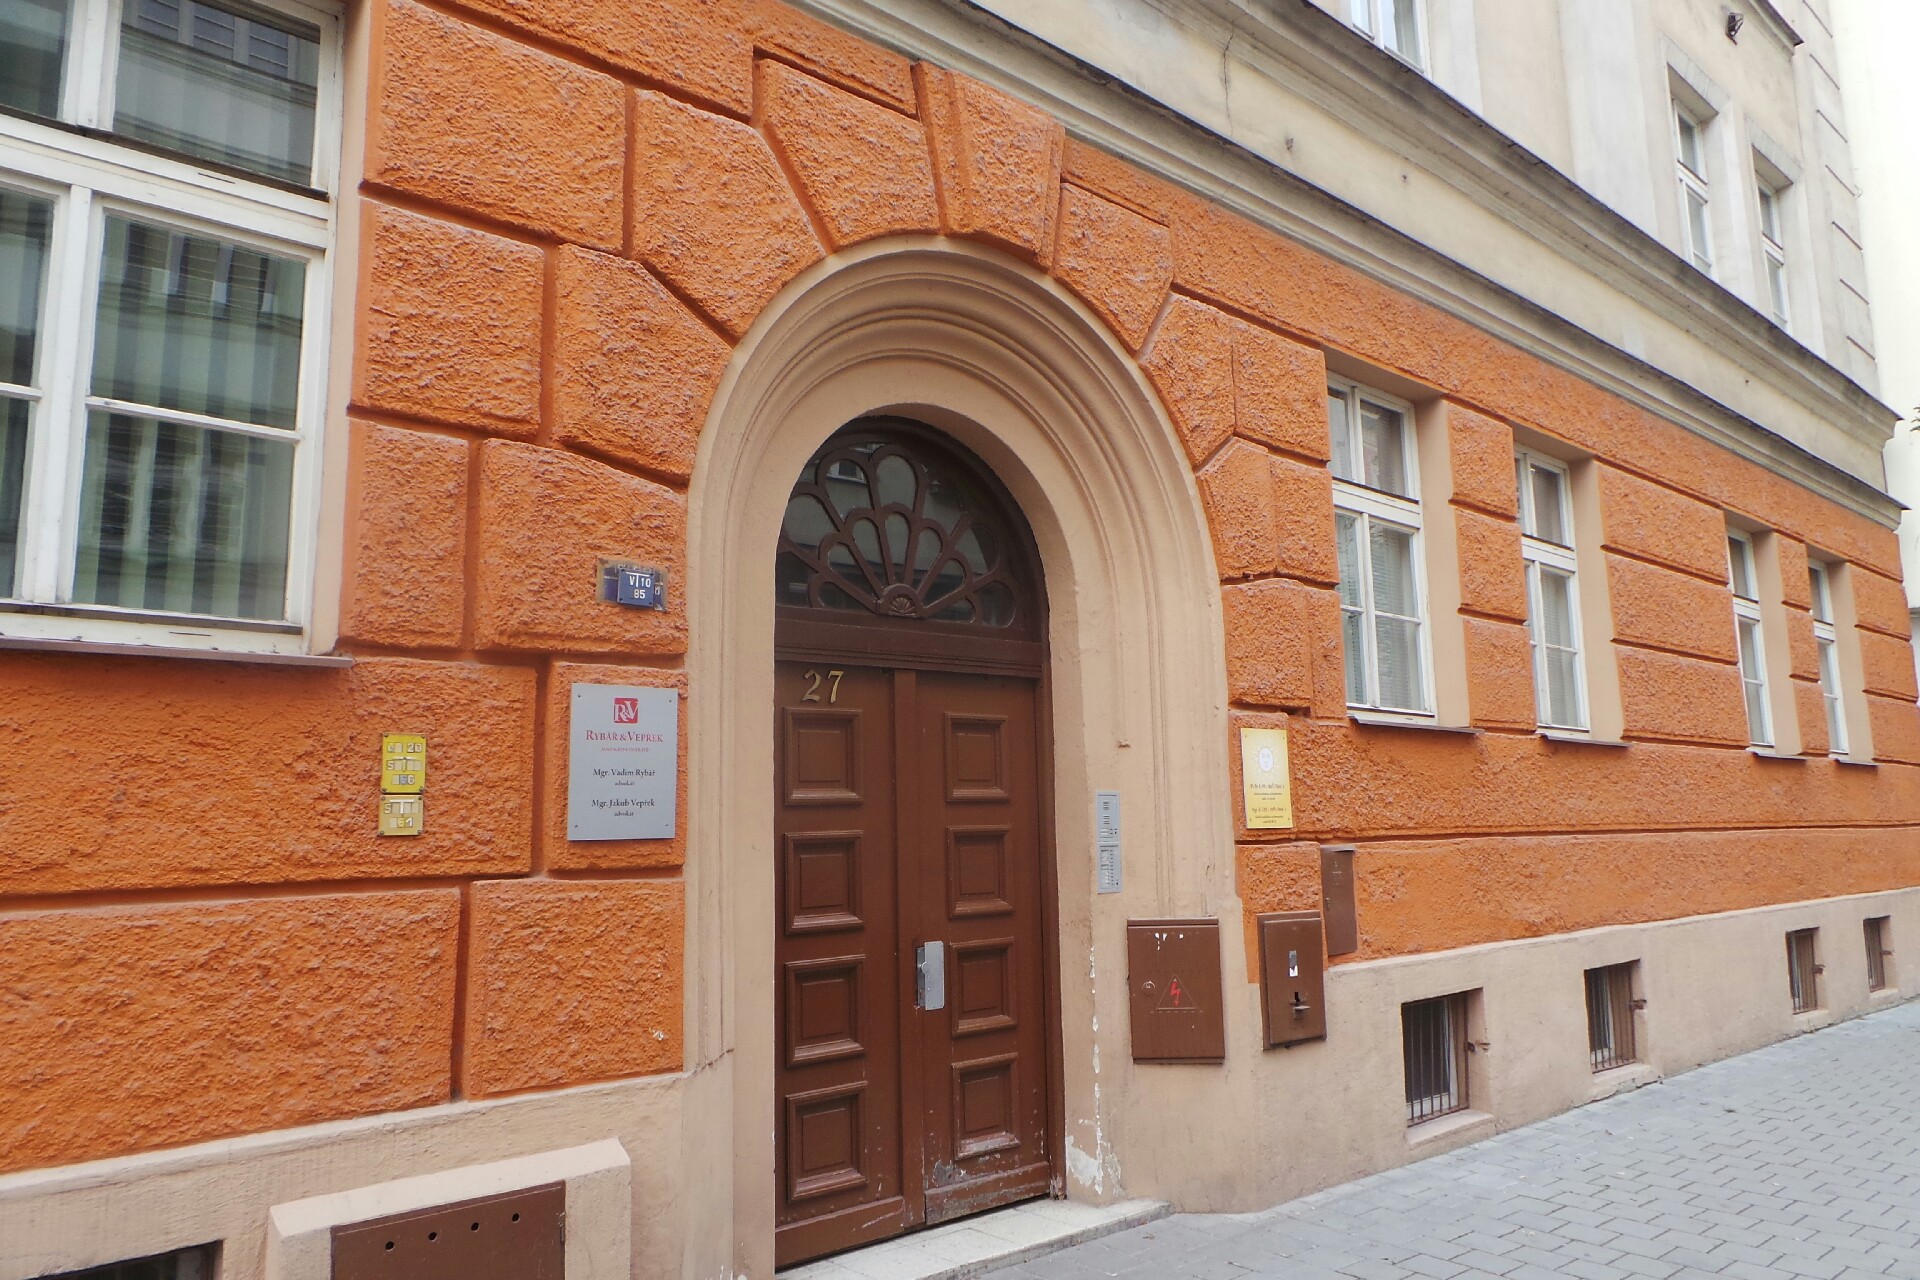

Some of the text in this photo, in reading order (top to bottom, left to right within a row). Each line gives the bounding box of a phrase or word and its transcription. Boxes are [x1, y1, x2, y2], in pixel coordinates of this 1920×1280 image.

[633, 588, 646, 600] 85
[802, 669, 844, 704] 27
[592, 768, 610, 779] Mgr.
[611, 768, 634, 777] Vadim
[591, 798, 655, 809] Mgr. Jakub Vepřek
